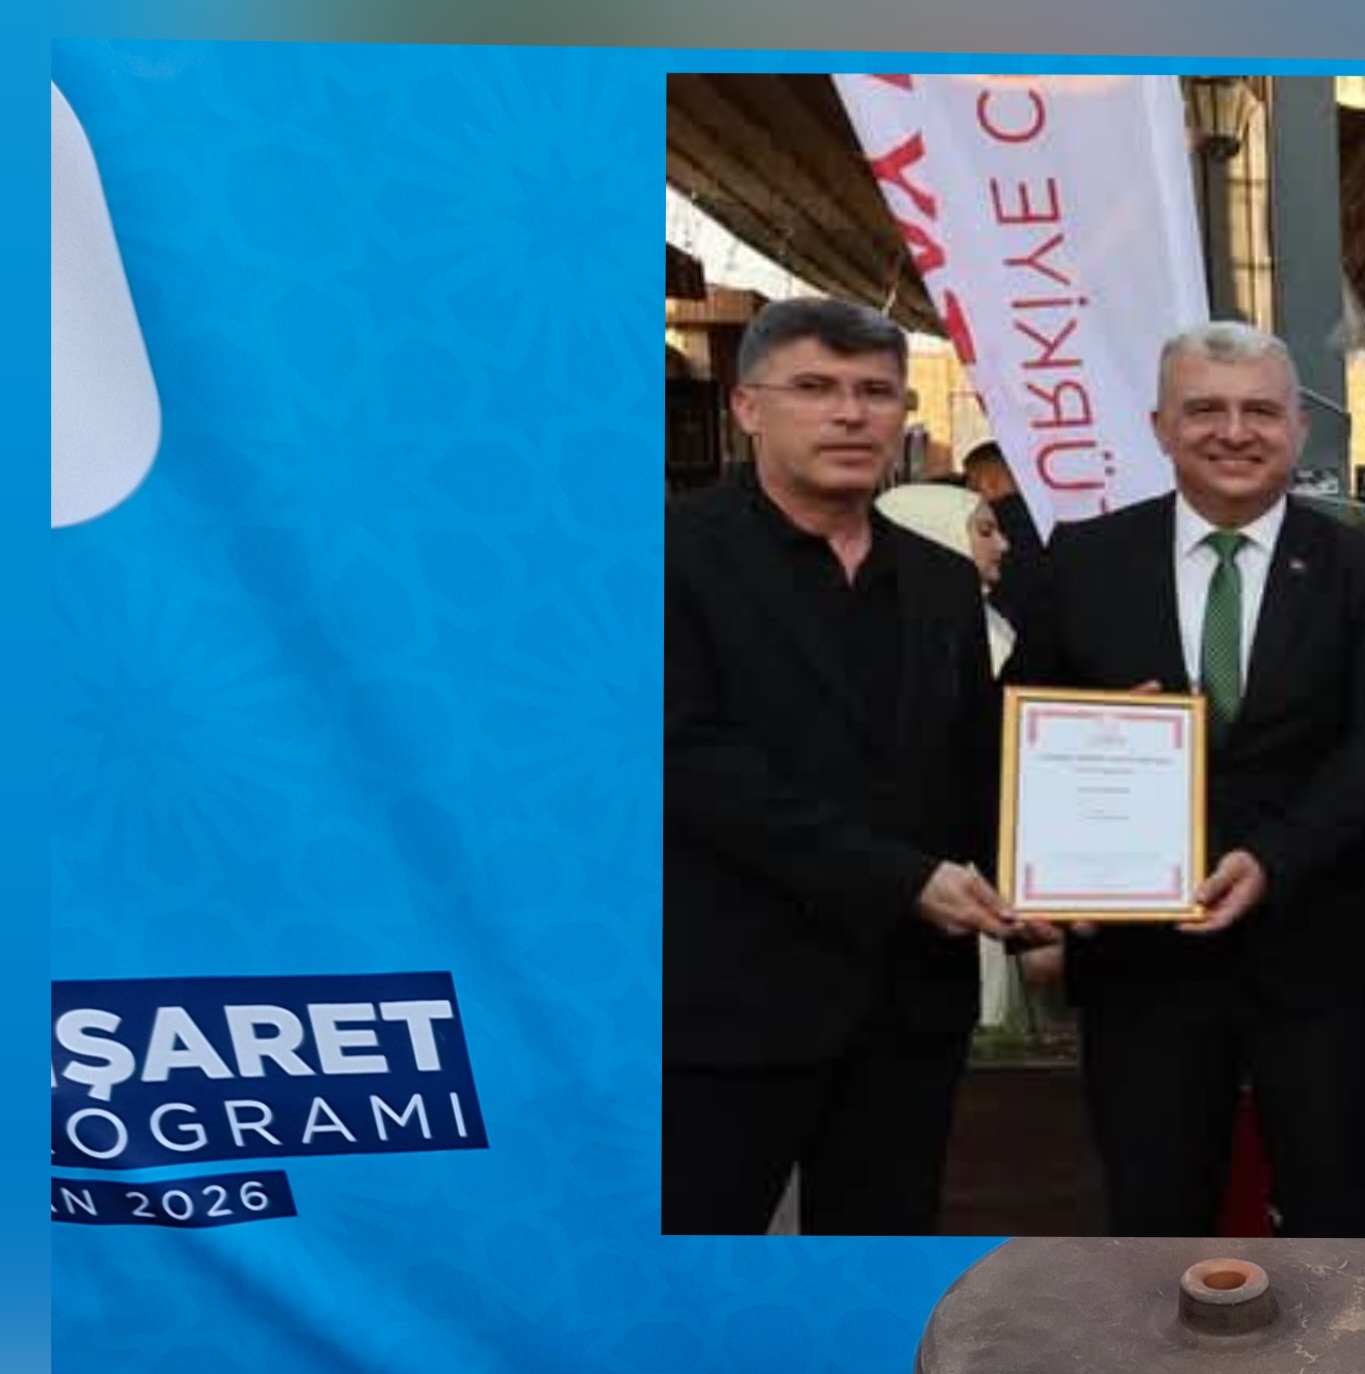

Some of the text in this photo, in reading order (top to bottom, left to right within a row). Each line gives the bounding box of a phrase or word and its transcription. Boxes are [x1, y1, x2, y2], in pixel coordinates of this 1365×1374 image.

[51, 999, 454, 1101] ŞARET
[52, 1092, 469, 1159] OGRAMI
[125, 1181, 269, 1220] 2026
